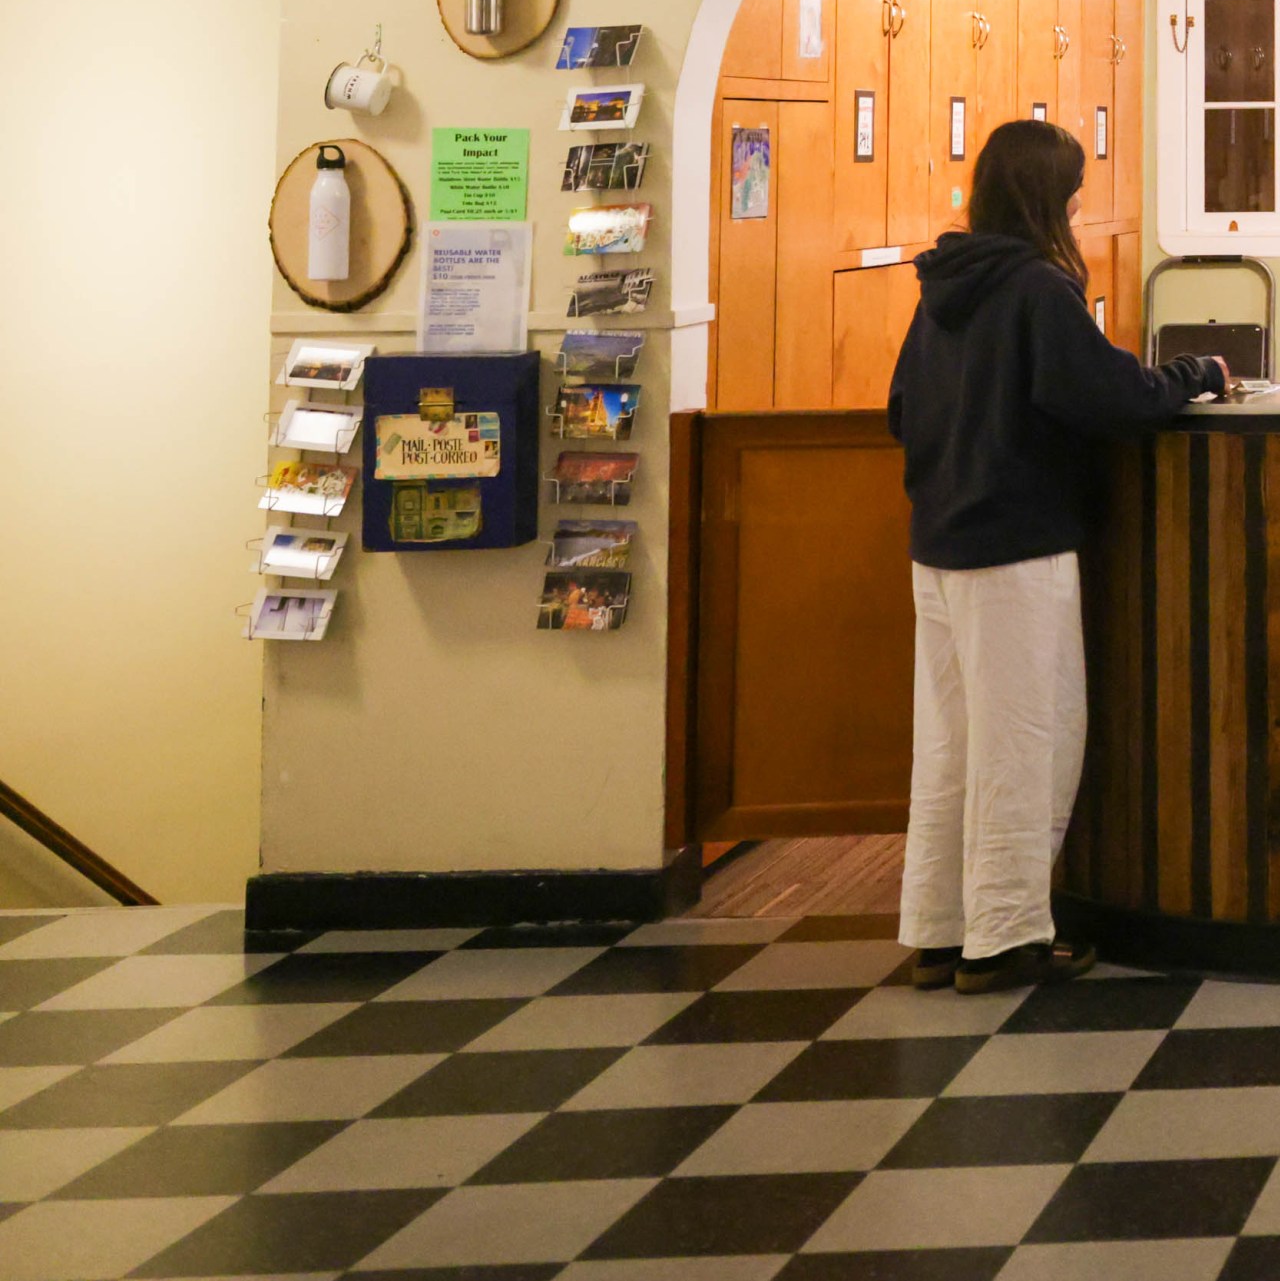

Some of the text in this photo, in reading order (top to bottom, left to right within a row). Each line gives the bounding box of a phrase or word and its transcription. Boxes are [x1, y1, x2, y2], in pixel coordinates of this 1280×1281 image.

[455, 133, 508, 142] Pack Your
[463, 148, 498, 158] Impact
